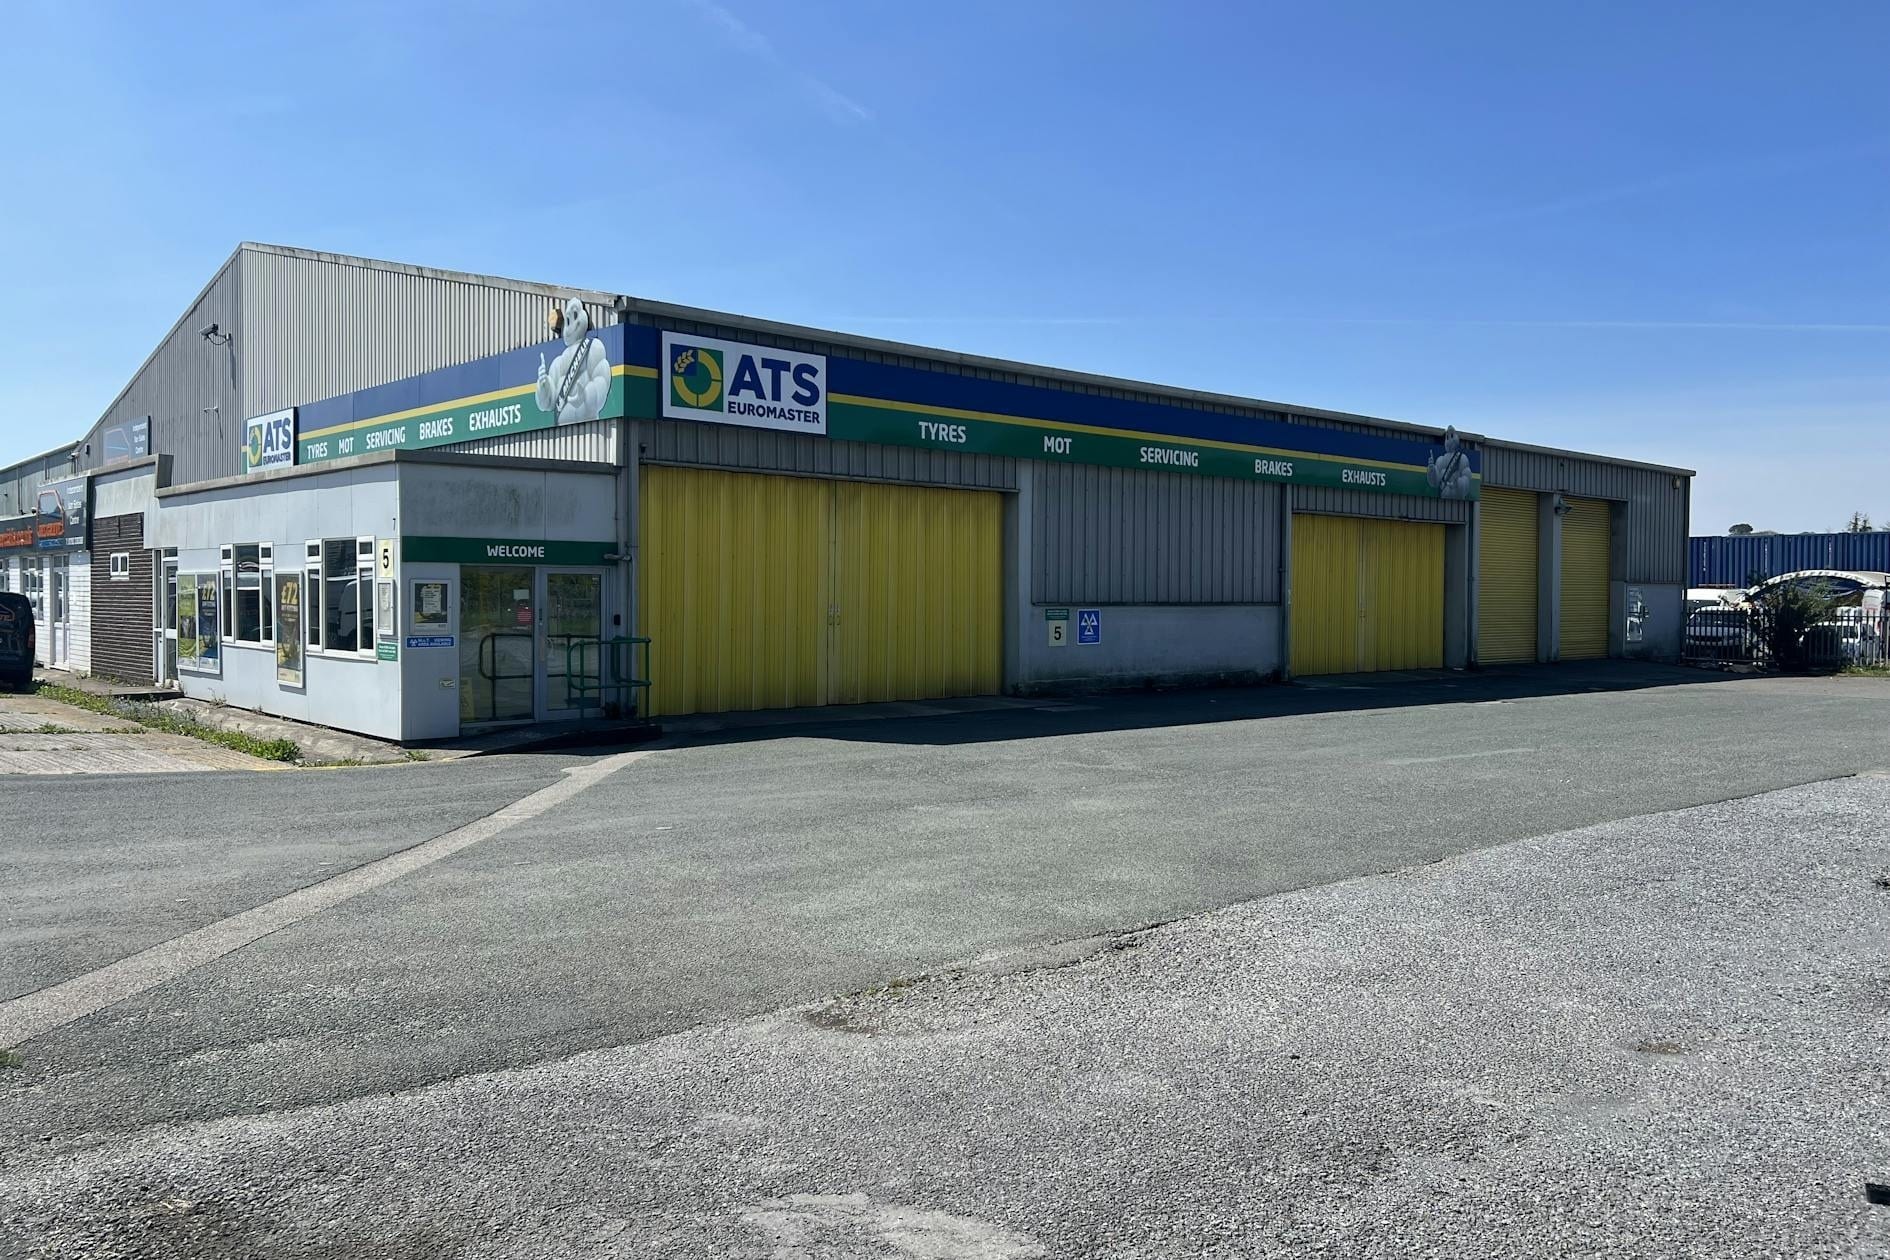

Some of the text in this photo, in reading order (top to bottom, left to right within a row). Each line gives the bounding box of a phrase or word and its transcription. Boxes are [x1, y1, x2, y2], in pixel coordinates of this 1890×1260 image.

[728, 354, 820, 407] ATS
[727, 400, 820, 424] EUROMASTER
[263, 417, 291, 453] ATS
[307, 404, 521, 460] TYRES MOT SERVICING BRAKES EXHAUSTS
[262, 452, 291, 465] EUROMASTER
[918, 421, 1386, 487] TYRES MOT SERVICING BRAKES EXHAUSTS
[382, 548, 389, 569] 5
[486, 545, 545, 558] WELCOME
[281, 581, 298, 604] £72
[1054, 626, 1062, 640] 5
